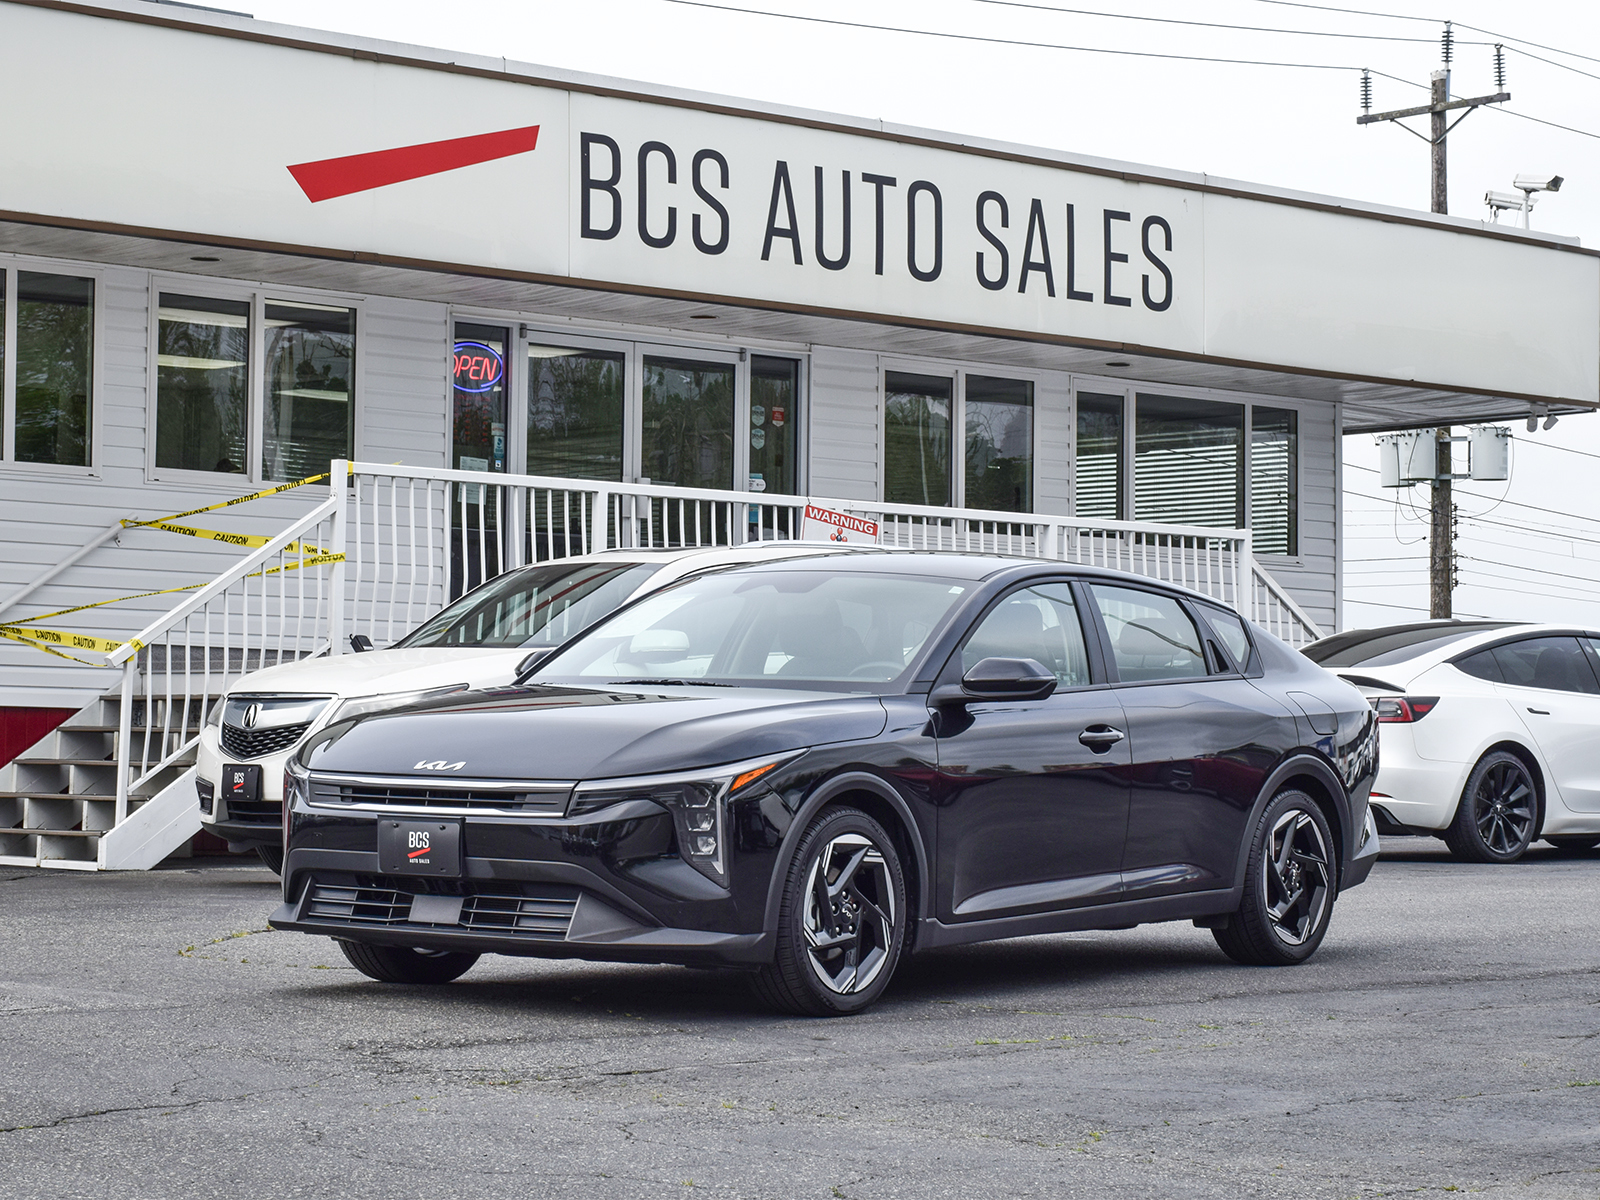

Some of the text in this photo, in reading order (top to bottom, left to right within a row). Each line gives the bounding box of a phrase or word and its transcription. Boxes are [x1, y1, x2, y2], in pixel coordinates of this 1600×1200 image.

[580, 131, 1173, 312] BCS AUTO SALES
[227, 492, 260, 506] CAUTION
[808, 506, 875, 534] WARNING
[160, 524, 249, 545] CAUTION CAUTION
[34, 630, 62, 643] CAUTION
[73, 636, 97, 650] CAUTION
[413, 760, 467, 771] KIA
[233, 772, 245, 784] BCS
[408, 831, 430, 848] BCS
[893, 854, 905, 902] KUMHO
